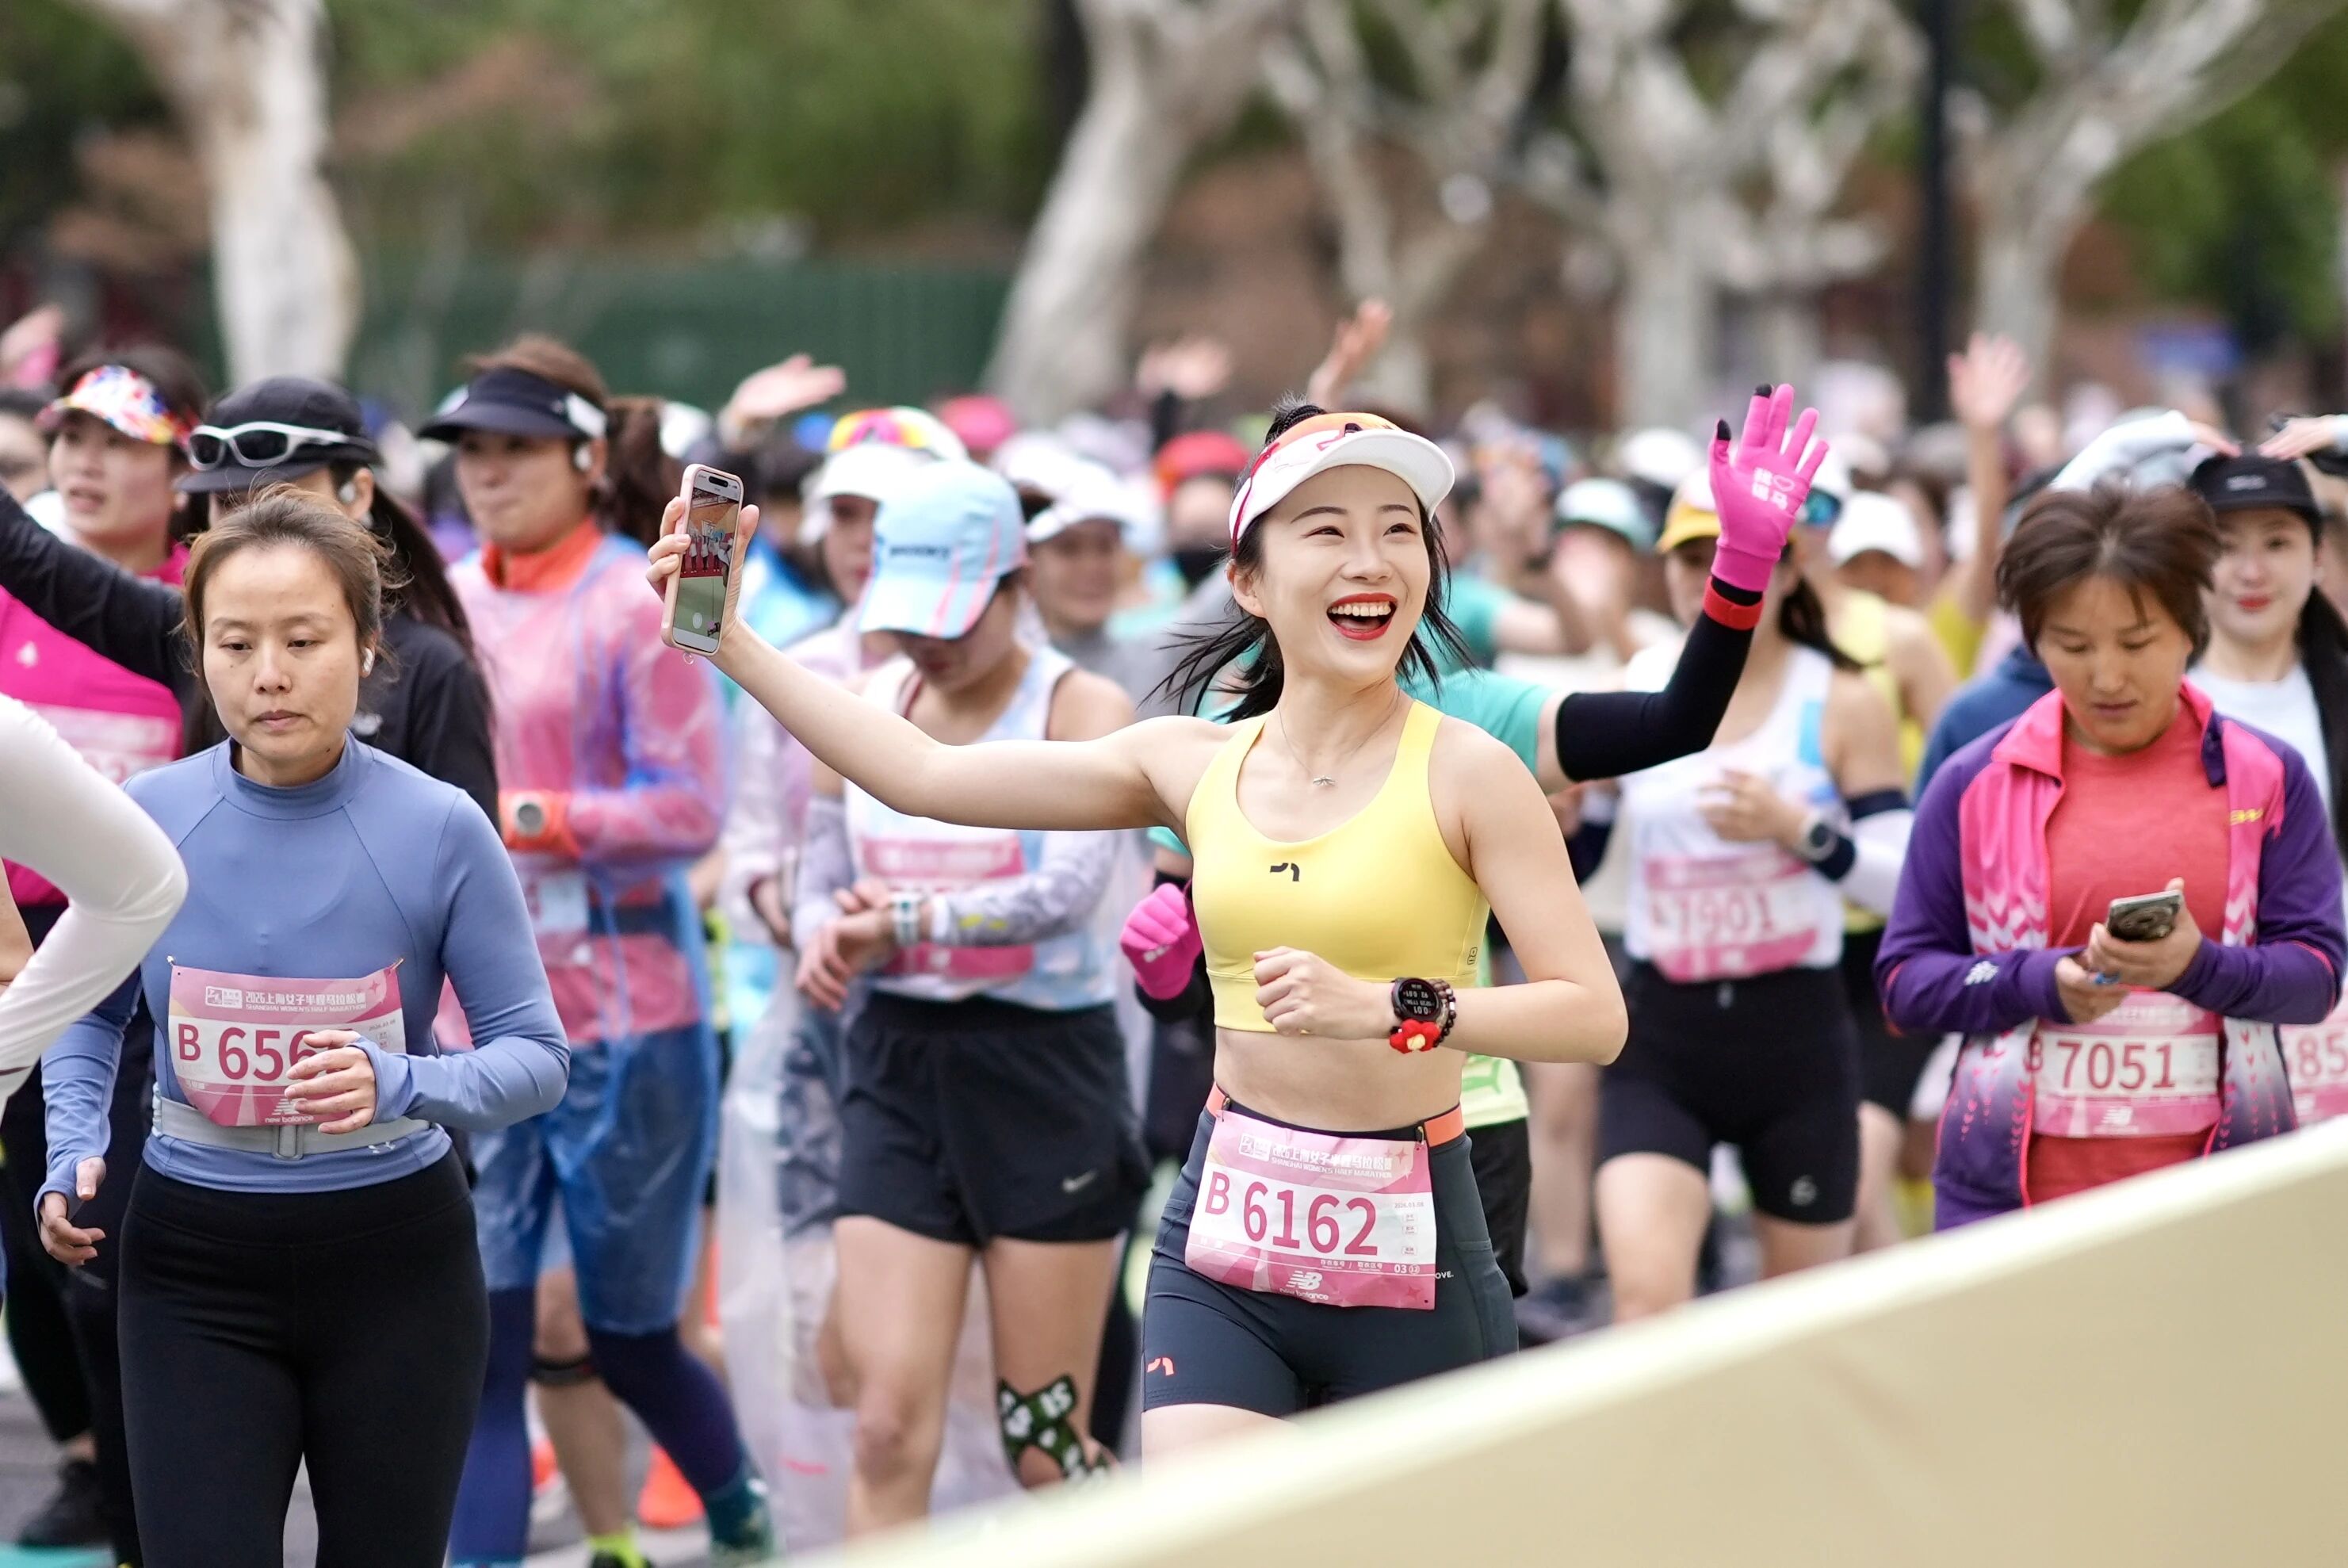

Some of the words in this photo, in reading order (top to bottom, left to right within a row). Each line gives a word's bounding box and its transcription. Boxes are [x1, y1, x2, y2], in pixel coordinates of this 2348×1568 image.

[178, 1023, 201, 1061] B
[218, 1027, 353, 1081] 656
[2056, 1039, 2176, 1090] 7051
[281, 1115, 314, 1123] balance
[1205, 1171, 1229, 1215] B
[1243, 1180, 1378, 1256] 6162
[1394, 1264, 1408, 1274] 03
